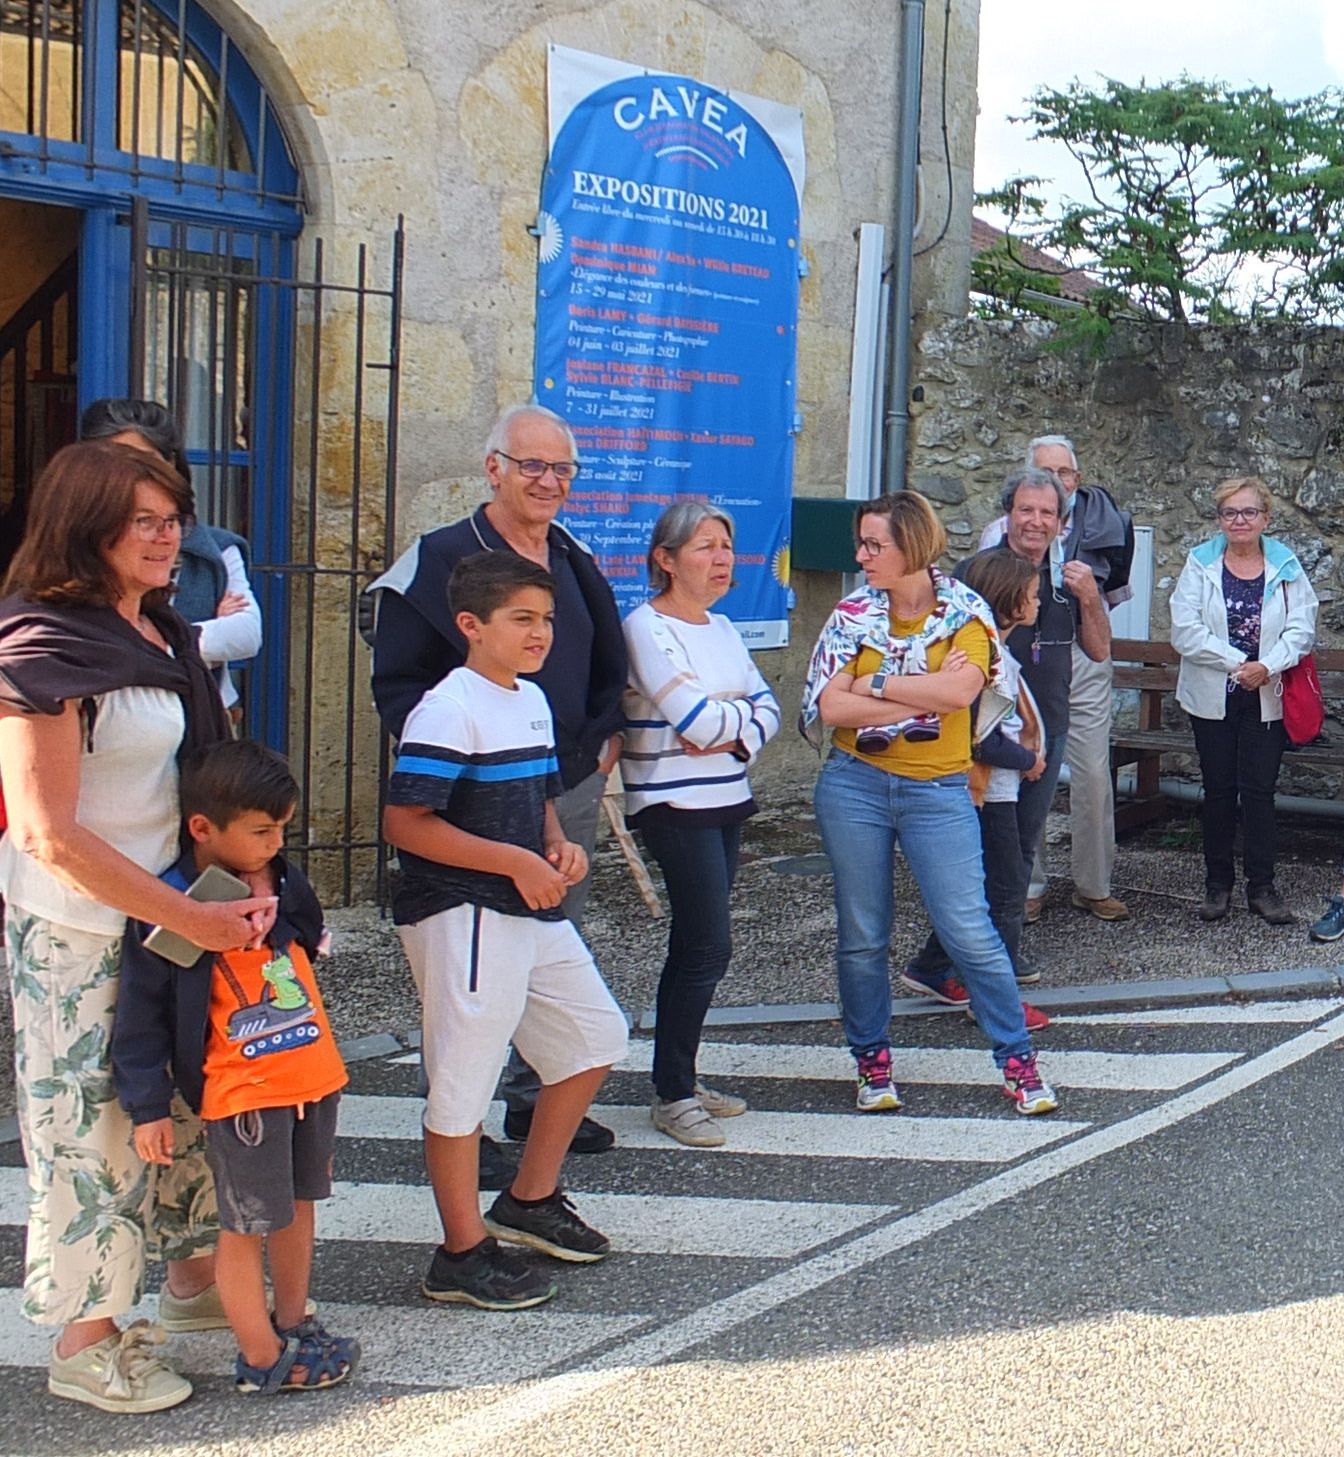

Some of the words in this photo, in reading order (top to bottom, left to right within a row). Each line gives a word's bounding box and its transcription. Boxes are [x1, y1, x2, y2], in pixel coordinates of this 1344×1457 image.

[613, 85, 749, 159] CAVEA
[572, 170, 725, 228] EXPOSITIONS
[728, 203, 769, 230] 2021
[570, 281, 583, 294] 15
[592, 285, 606, 298] 29
[607, 289, 626, 301] mai
[627, 289, 653, 304] 2021
[580, 338, 603, 352] juin
[611, 341, 624, 352] 03
[623, 342, 655, 357] juillet
[656, 346, 681, 358] 2021
[566, 401, 574, 413] 7
[584, 403, 598, 416] 31
[598, 404, 628, 420] juillet
[629, 406, 655, 420] 2021
[571, 426, 625, 439] ssociation
[618, 469, 644, 482] 2021
[592, 532, 643, 548] Septembre
